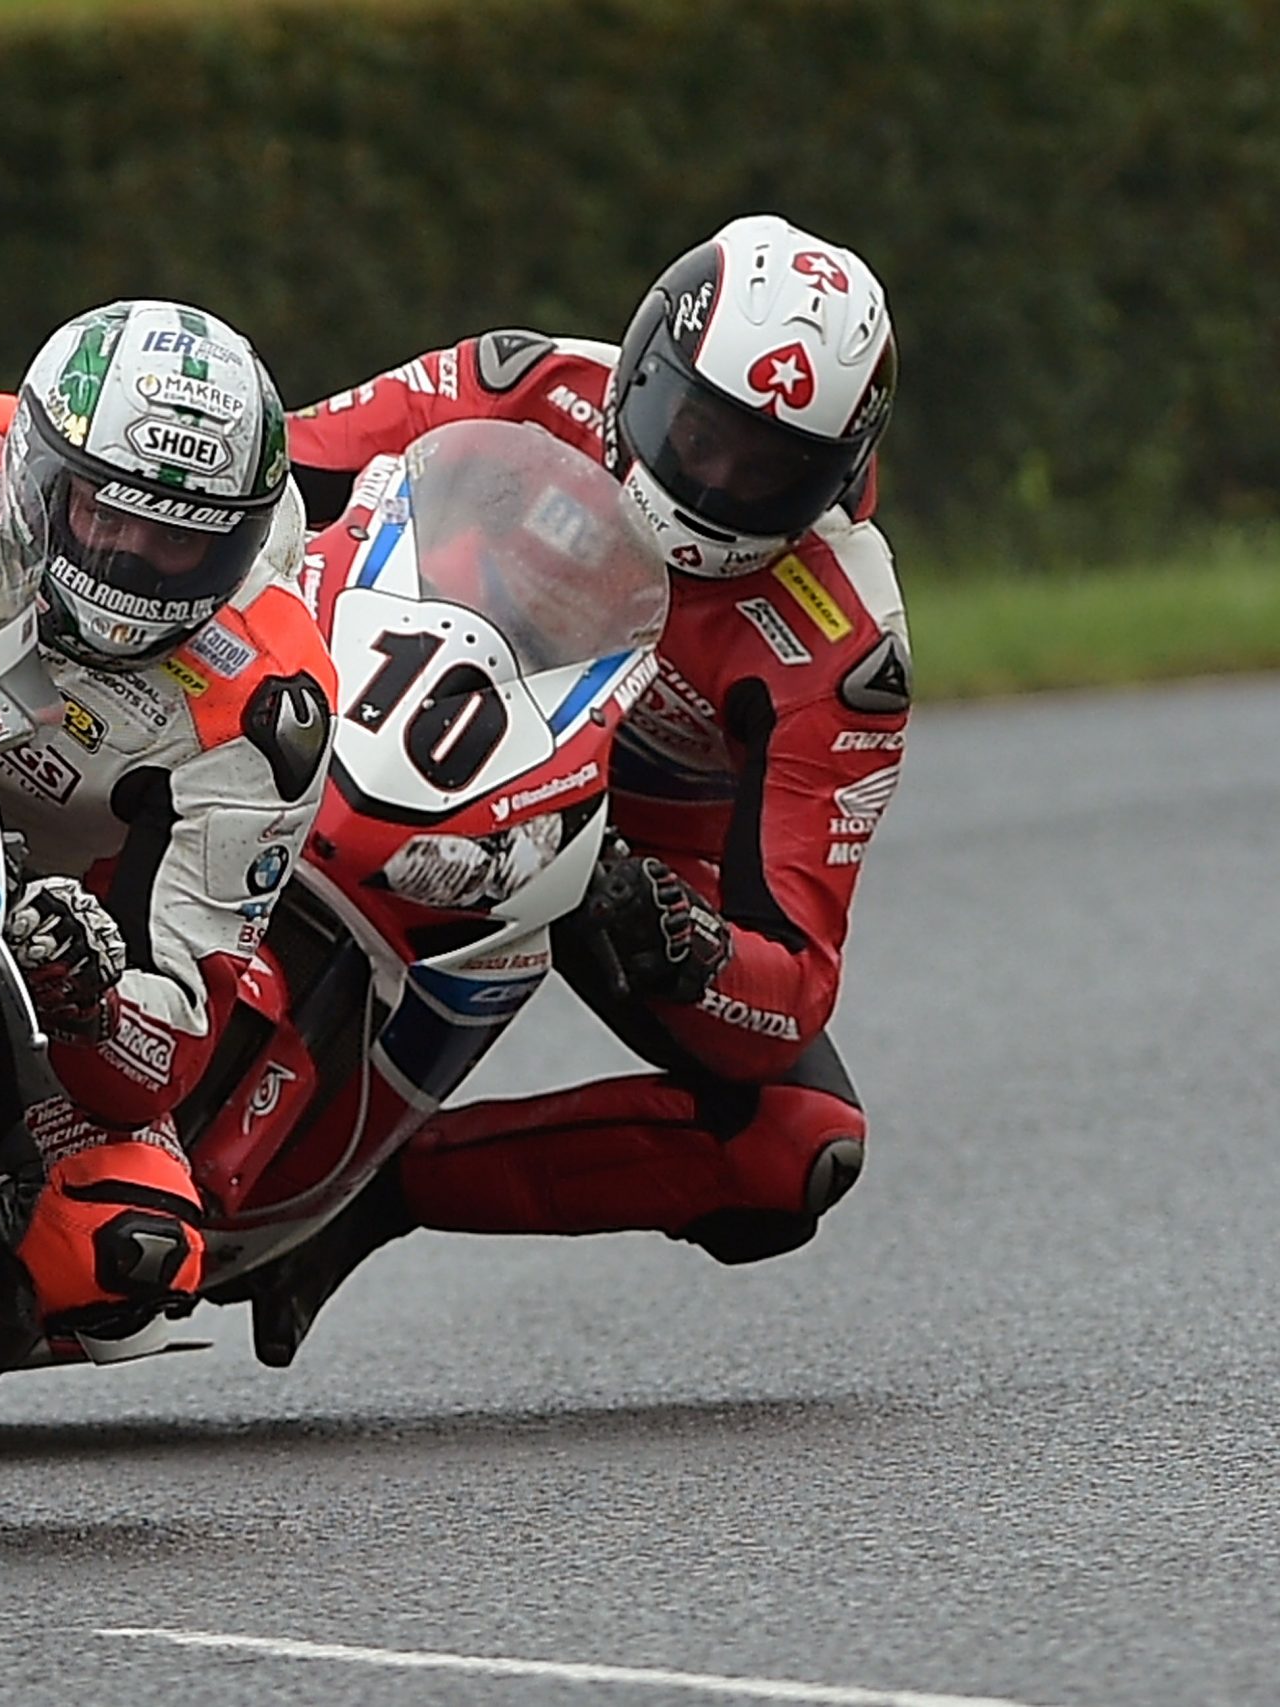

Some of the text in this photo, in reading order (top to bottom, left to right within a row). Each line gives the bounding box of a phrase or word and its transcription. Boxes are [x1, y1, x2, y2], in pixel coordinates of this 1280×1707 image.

[142, 331, 195, 355] IER
[164, 376, 244, 413] MAKREP
[548, 385, 605, 439] MOT
[145, 426, 218, 466] SHOEI
[100, 481, 246, 528] NOLAN OILS
[793, 575, 840, 629] DUNLOP
[163, 661, 205, 694] NLOP
[141, 702, 167, 728] LTD
[345, 630, 509, 794] 10
[696, 987, 801, 1041] HONDA
[119, 1019, 171, 1068] BRIGGS
